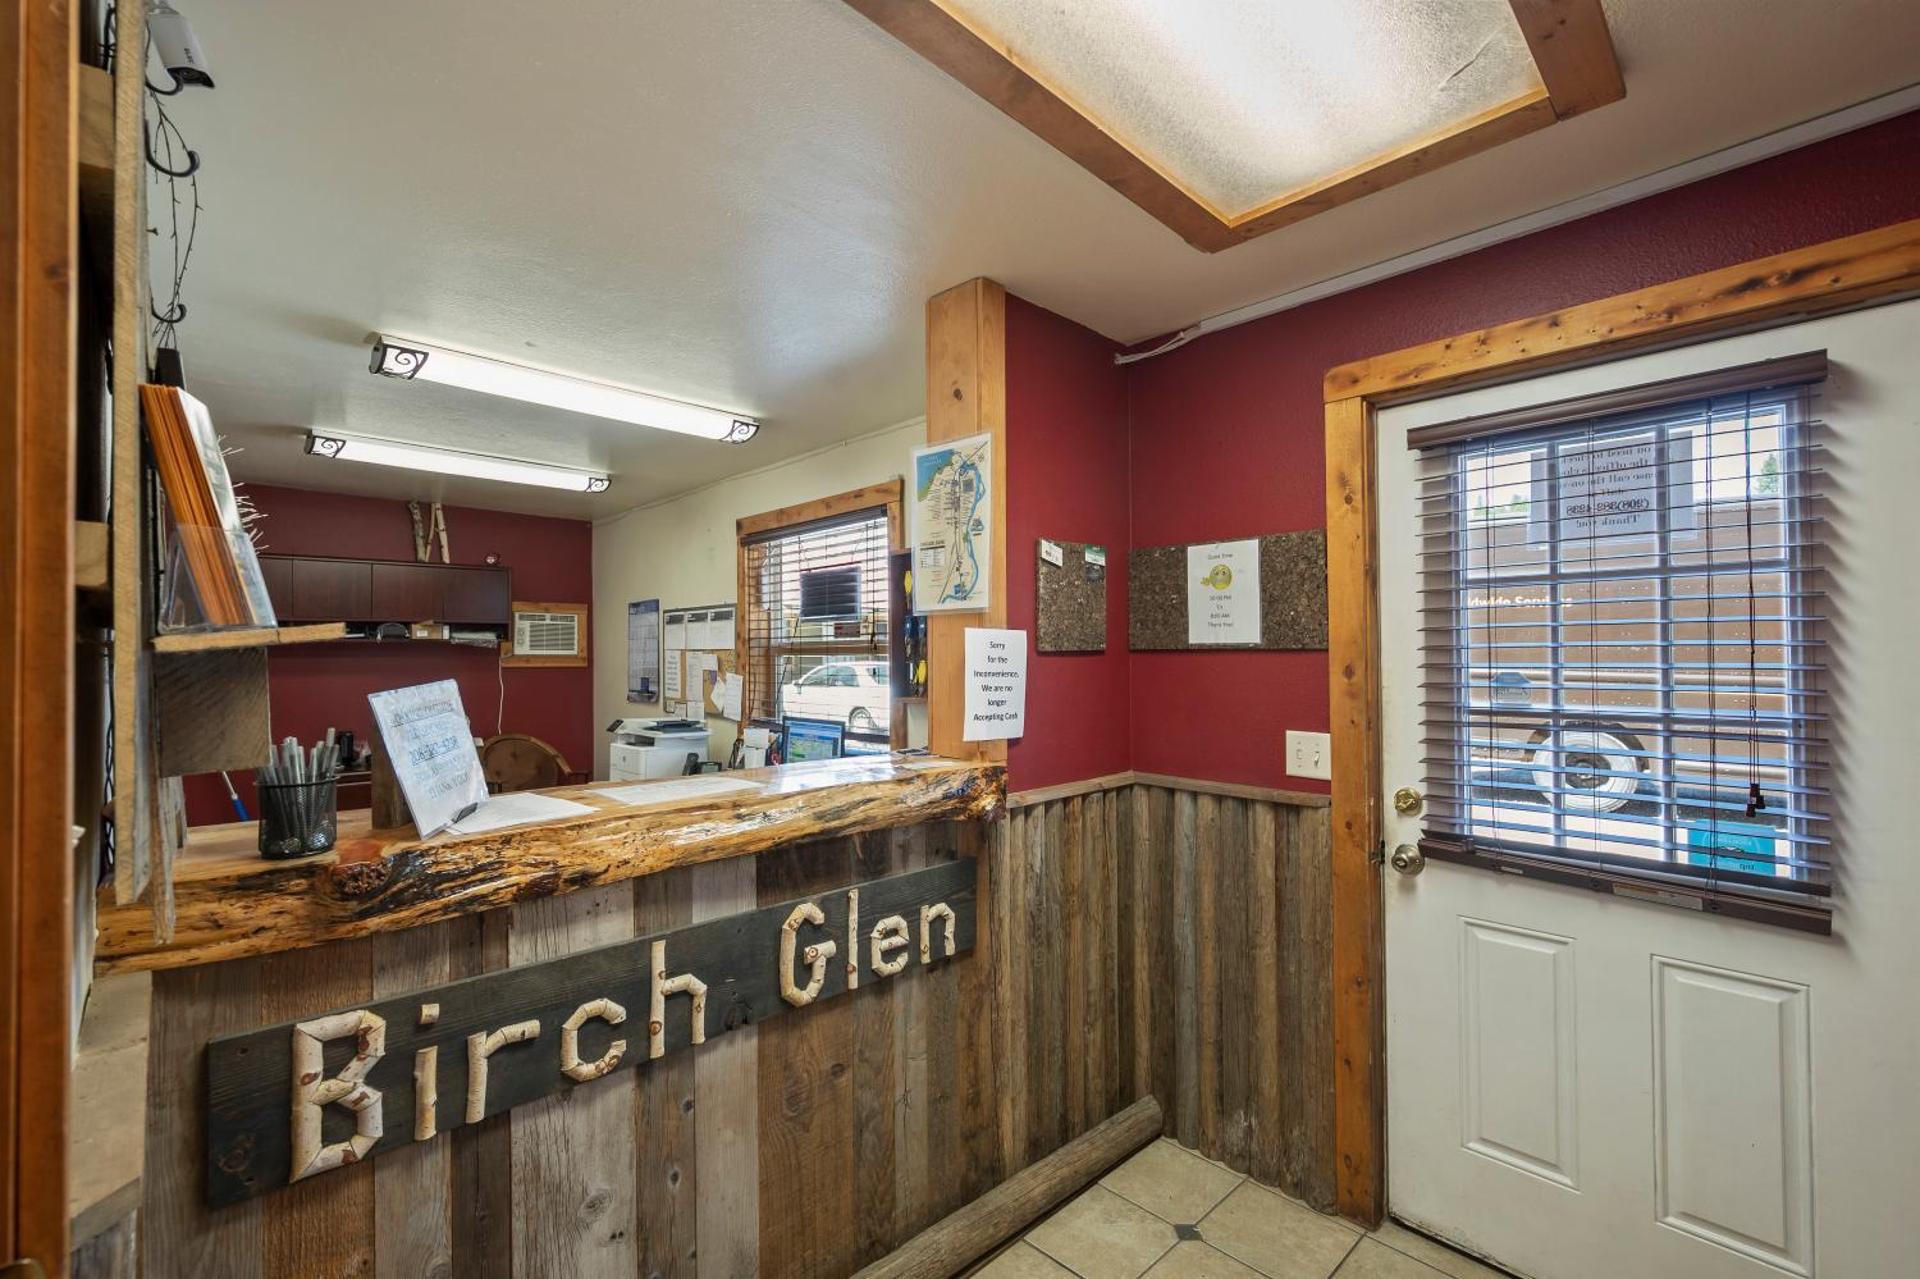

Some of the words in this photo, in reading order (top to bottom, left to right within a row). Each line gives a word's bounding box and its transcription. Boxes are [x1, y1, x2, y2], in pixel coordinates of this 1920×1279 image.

[989, 641, 1006, 650] Sorry
[987, 655, 997, 664] for
[998, 656, 1008, 664] the
[981, 683, 993, 692] We
[987, 698, 1007, 707] longer
[973, 712, 1004, 722] Accepting
[1004, 711, 1018, 720] Cash
[289, 939, 708, 1184] Birch
[779, 888, 957, 1008] Glen
